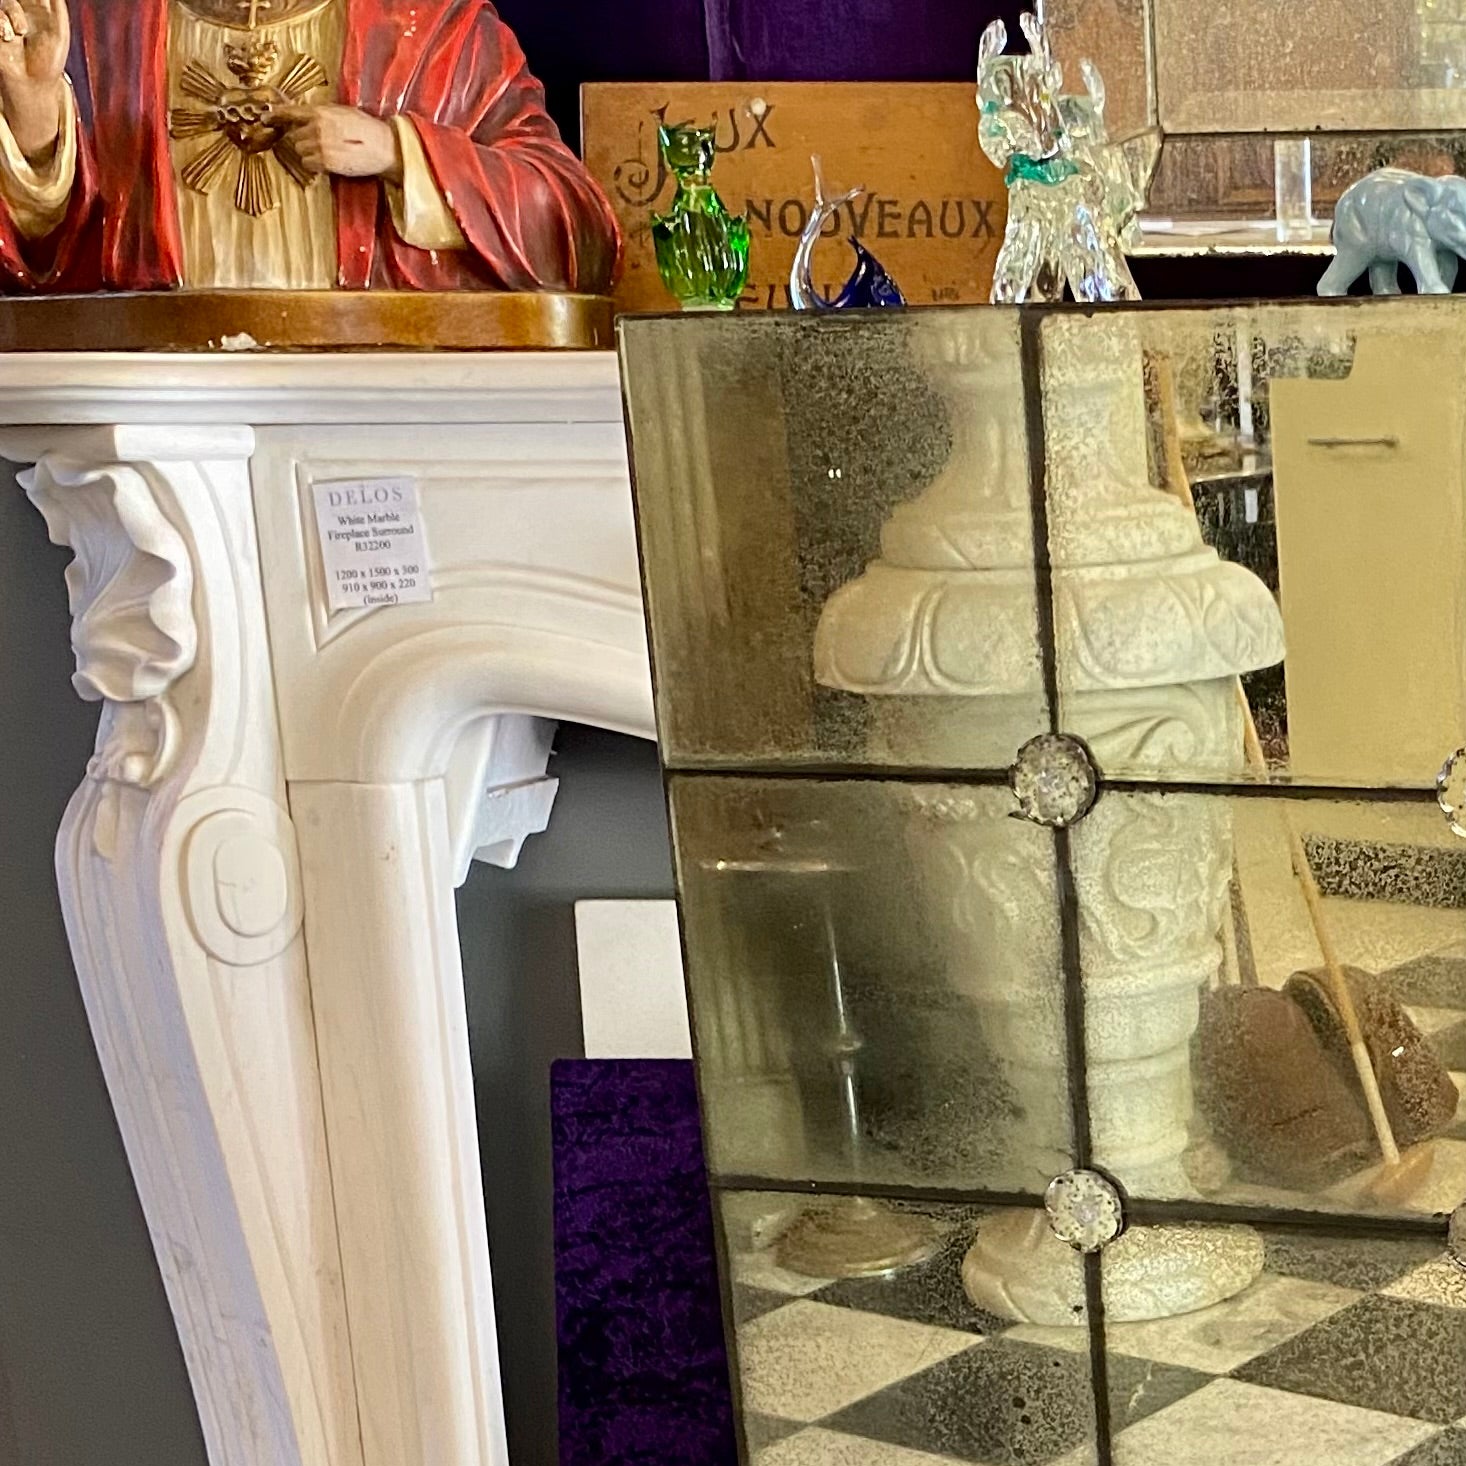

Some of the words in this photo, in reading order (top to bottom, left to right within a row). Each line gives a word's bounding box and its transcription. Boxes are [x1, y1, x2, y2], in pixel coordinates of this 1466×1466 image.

[613, 101, 776, 207] JUX
[328, 487, 404, 507] DELOS
[337, 515, 366, 526] White
[367, 512, 401, 524] Marble
[327, 529, 370, 541] Fireplace
[372, 525, 414, 537] Surround
[355, 541, 391, 552] R32200
[336, 570, 358, 581] 1200
[368, 567, 391, 578] 1500
[342, 582, 360, 593] 910
[370, 580, 388, 591] 900
[399, 578, 416, 589] 220
[363, 593, 399, 606] (inside)
